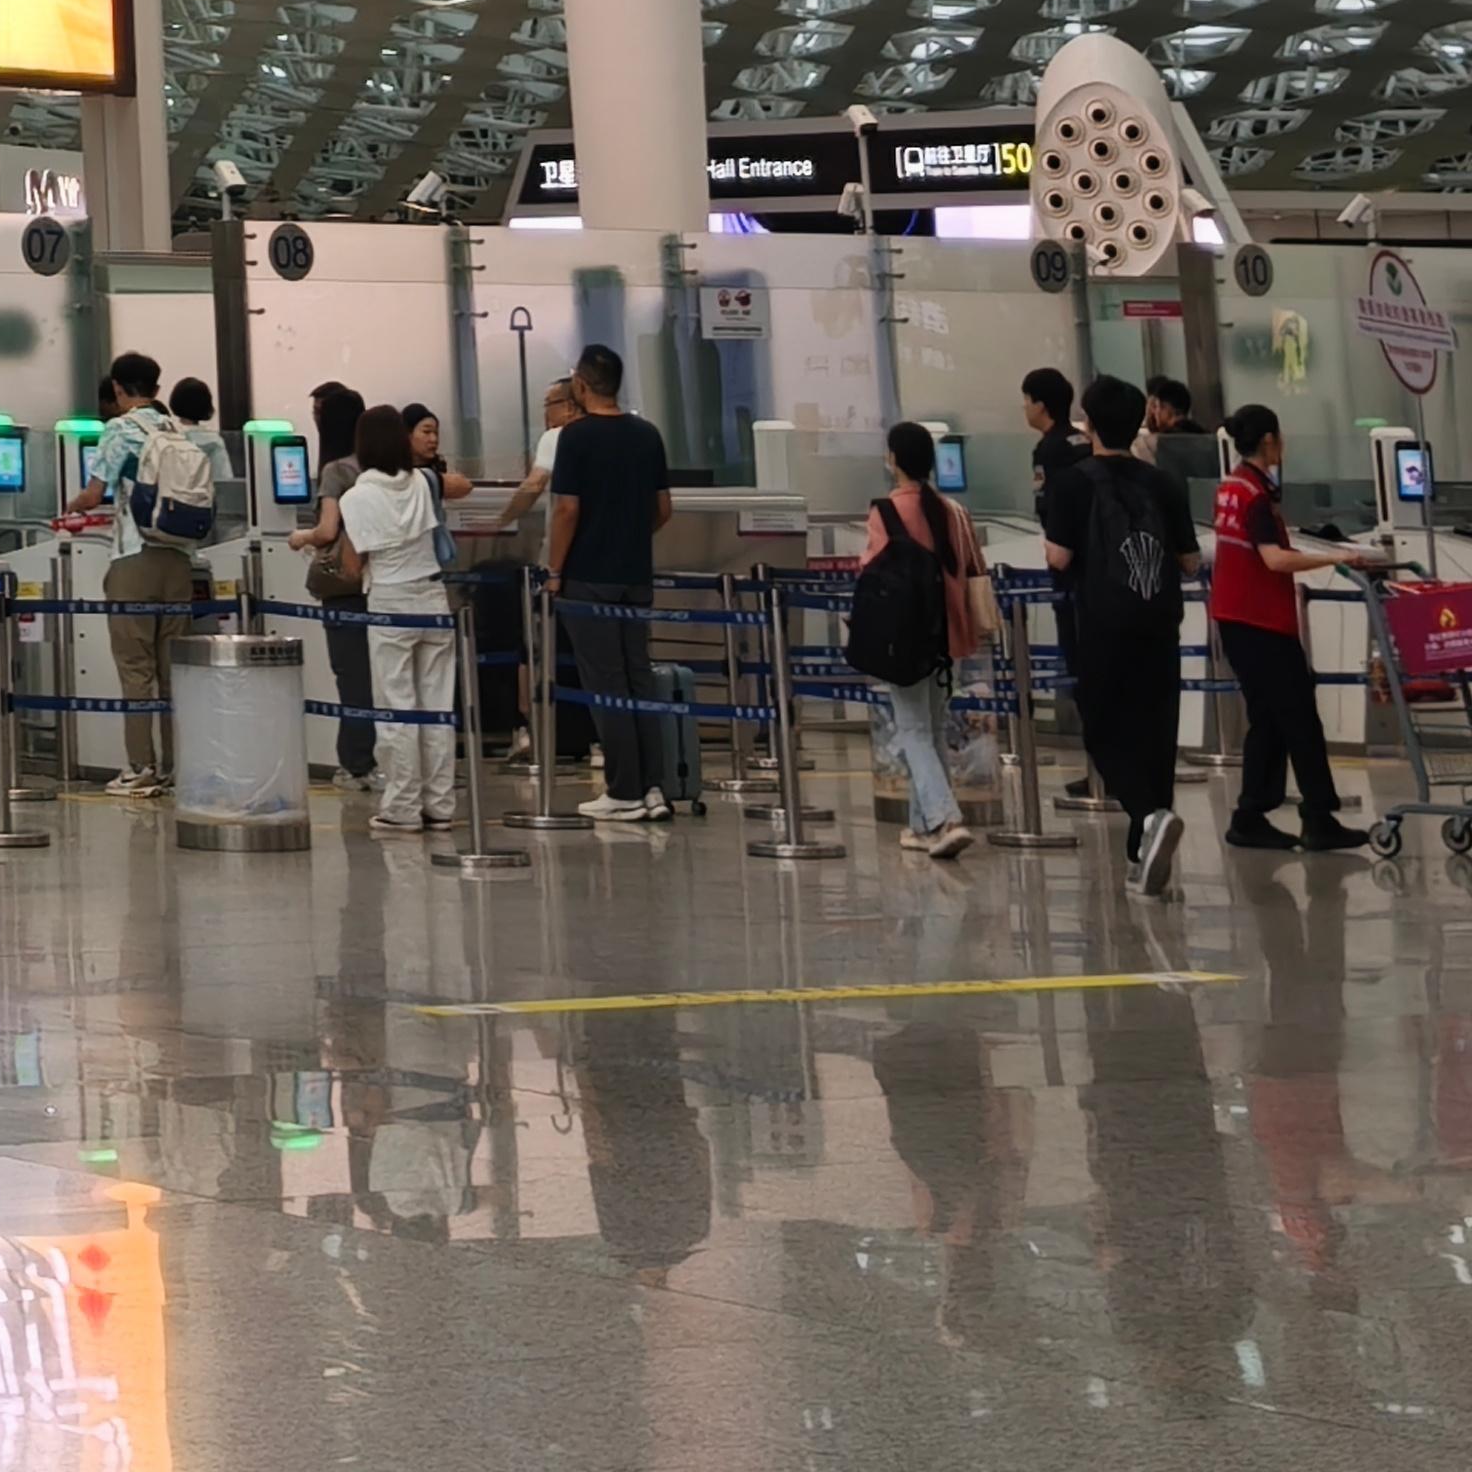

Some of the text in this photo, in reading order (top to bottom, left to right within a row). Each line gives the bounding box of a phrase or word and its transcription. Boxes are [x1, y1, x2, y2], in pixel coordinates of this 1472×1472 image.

[738, 157, 814, 179] Entrance
[25, 228, 65, 265] 07
[272, 235, 310, 271] 08
[1034, 251, 1068, 283] 09
[1238, 254, 1268, 287] 10
